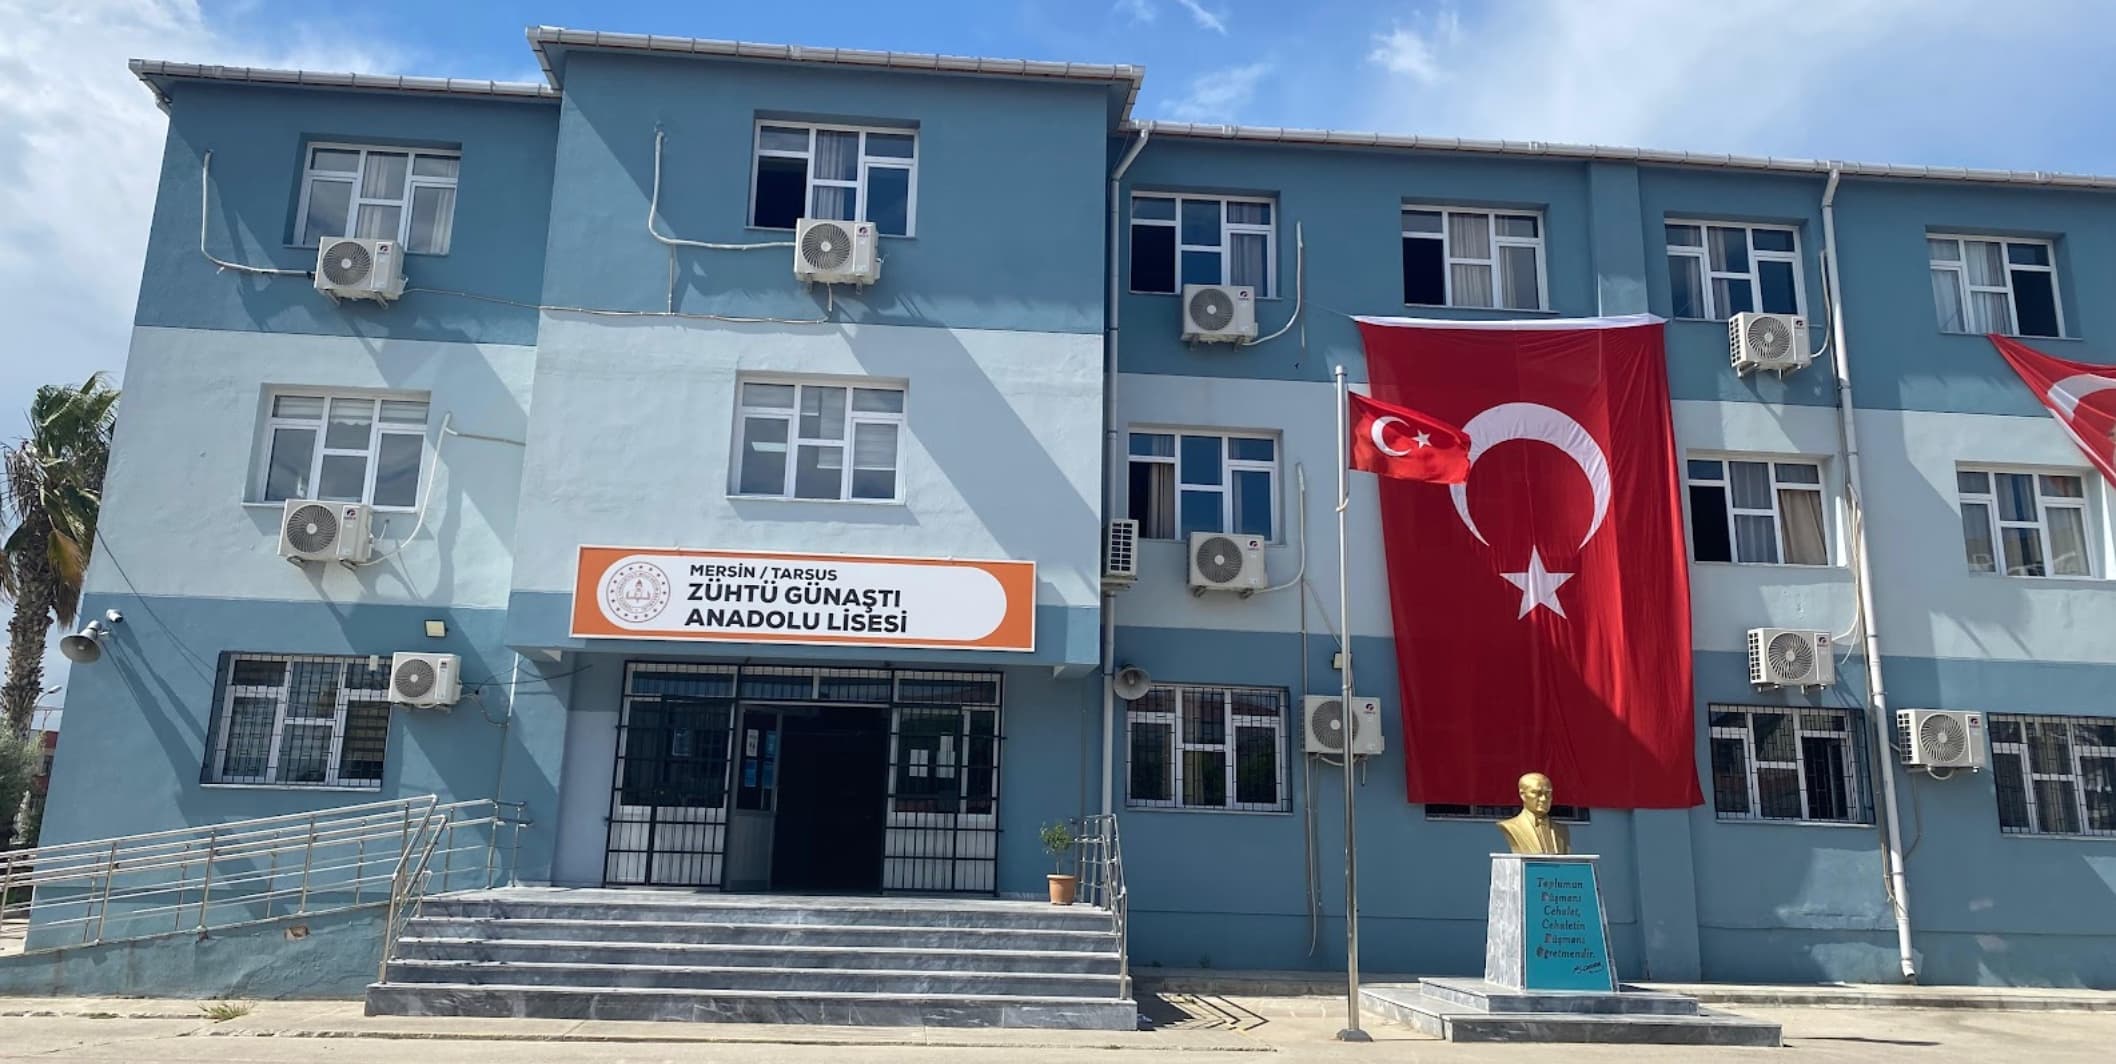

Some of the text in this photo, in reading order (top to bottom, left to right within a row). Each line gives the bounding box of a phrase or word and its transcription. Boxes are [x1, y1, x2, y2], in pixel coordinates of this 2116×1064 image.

[690, 563, 756, 578] MERSİN
[771, 567, 838, 581] TARSUS
[687, 578, 778, 603] ZÜHTÜ
[784, 582, 901, 613] GÜNAŞTI
[684, 608, 907, 633] ANADOLU LİSESİ
